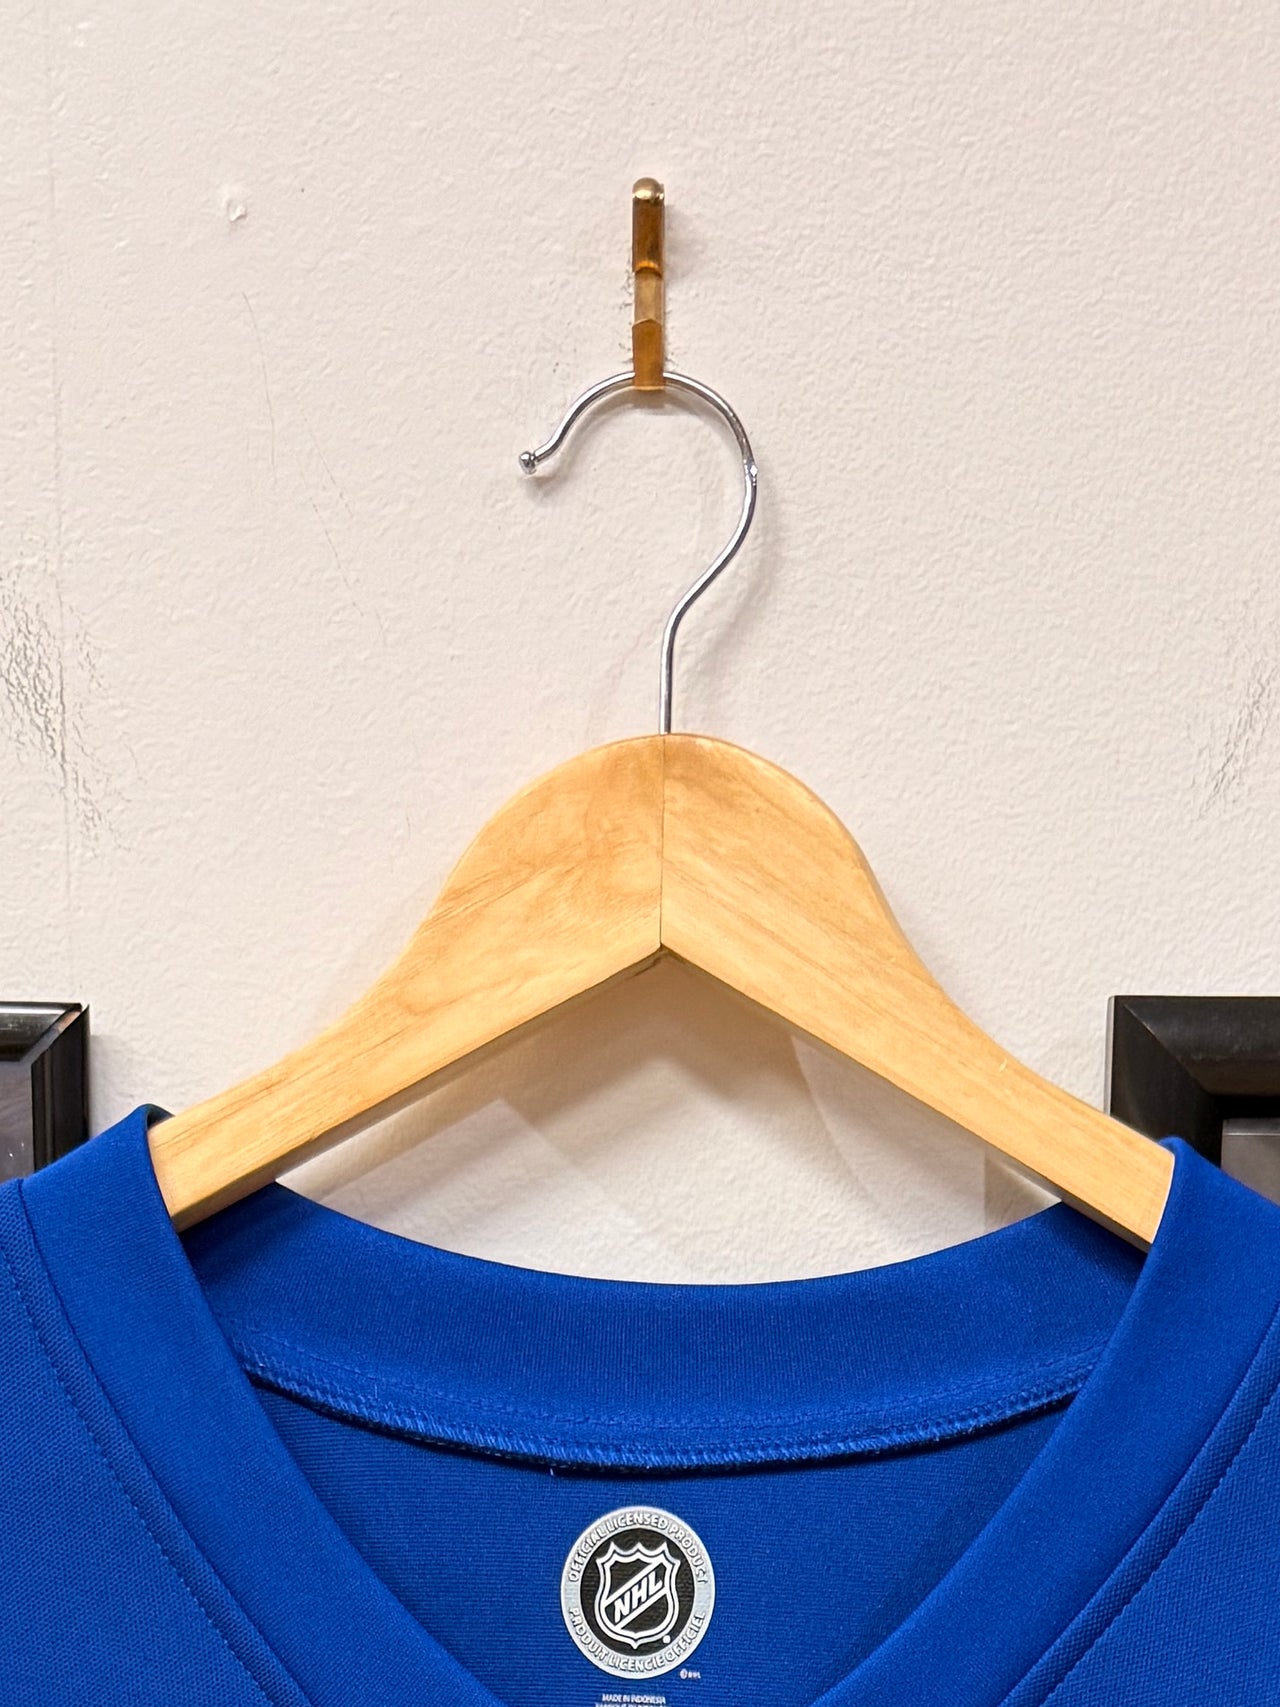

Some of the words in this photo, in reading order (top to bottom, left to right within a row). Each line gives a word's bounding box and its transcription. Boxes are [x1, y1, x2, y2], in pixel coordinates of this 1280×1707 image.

[568, 1528, 608, 1583] OFFICIAL
[606, 1512, 669, 1533] LICENSED
[668, 1524, 709, 1585] PRODUCT
[613, 1568, 665, 1624] NHL
[568, 1607, 609, 1662] PRODUIT
[664, 1610, 707, 1664] OFFICIEL
